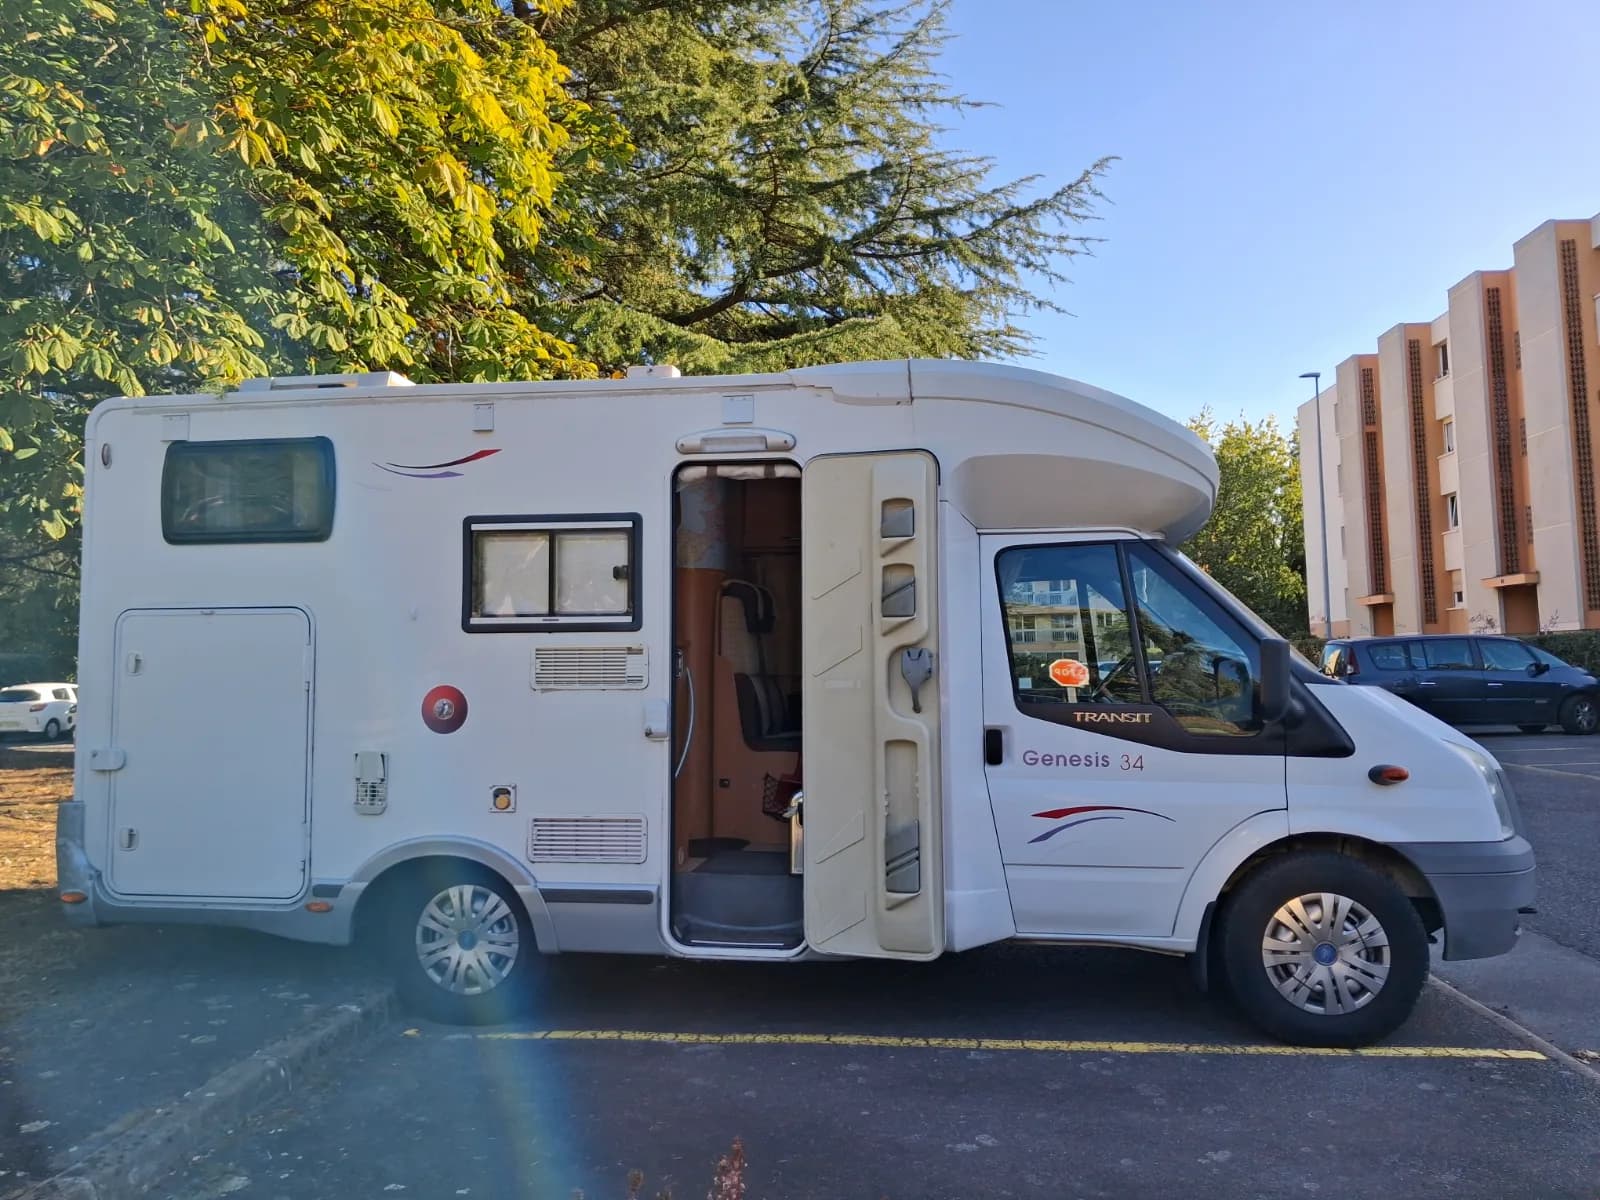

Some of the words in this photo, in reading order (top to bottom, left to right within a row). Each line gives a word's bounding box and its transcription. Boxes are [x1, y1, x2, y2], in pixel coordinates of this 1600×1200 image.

[1073, 711, 1152, 723] TRANSIT
[1022, 750, 1110, 768] Genesis
[1119, 754, 1144, 771] 34
